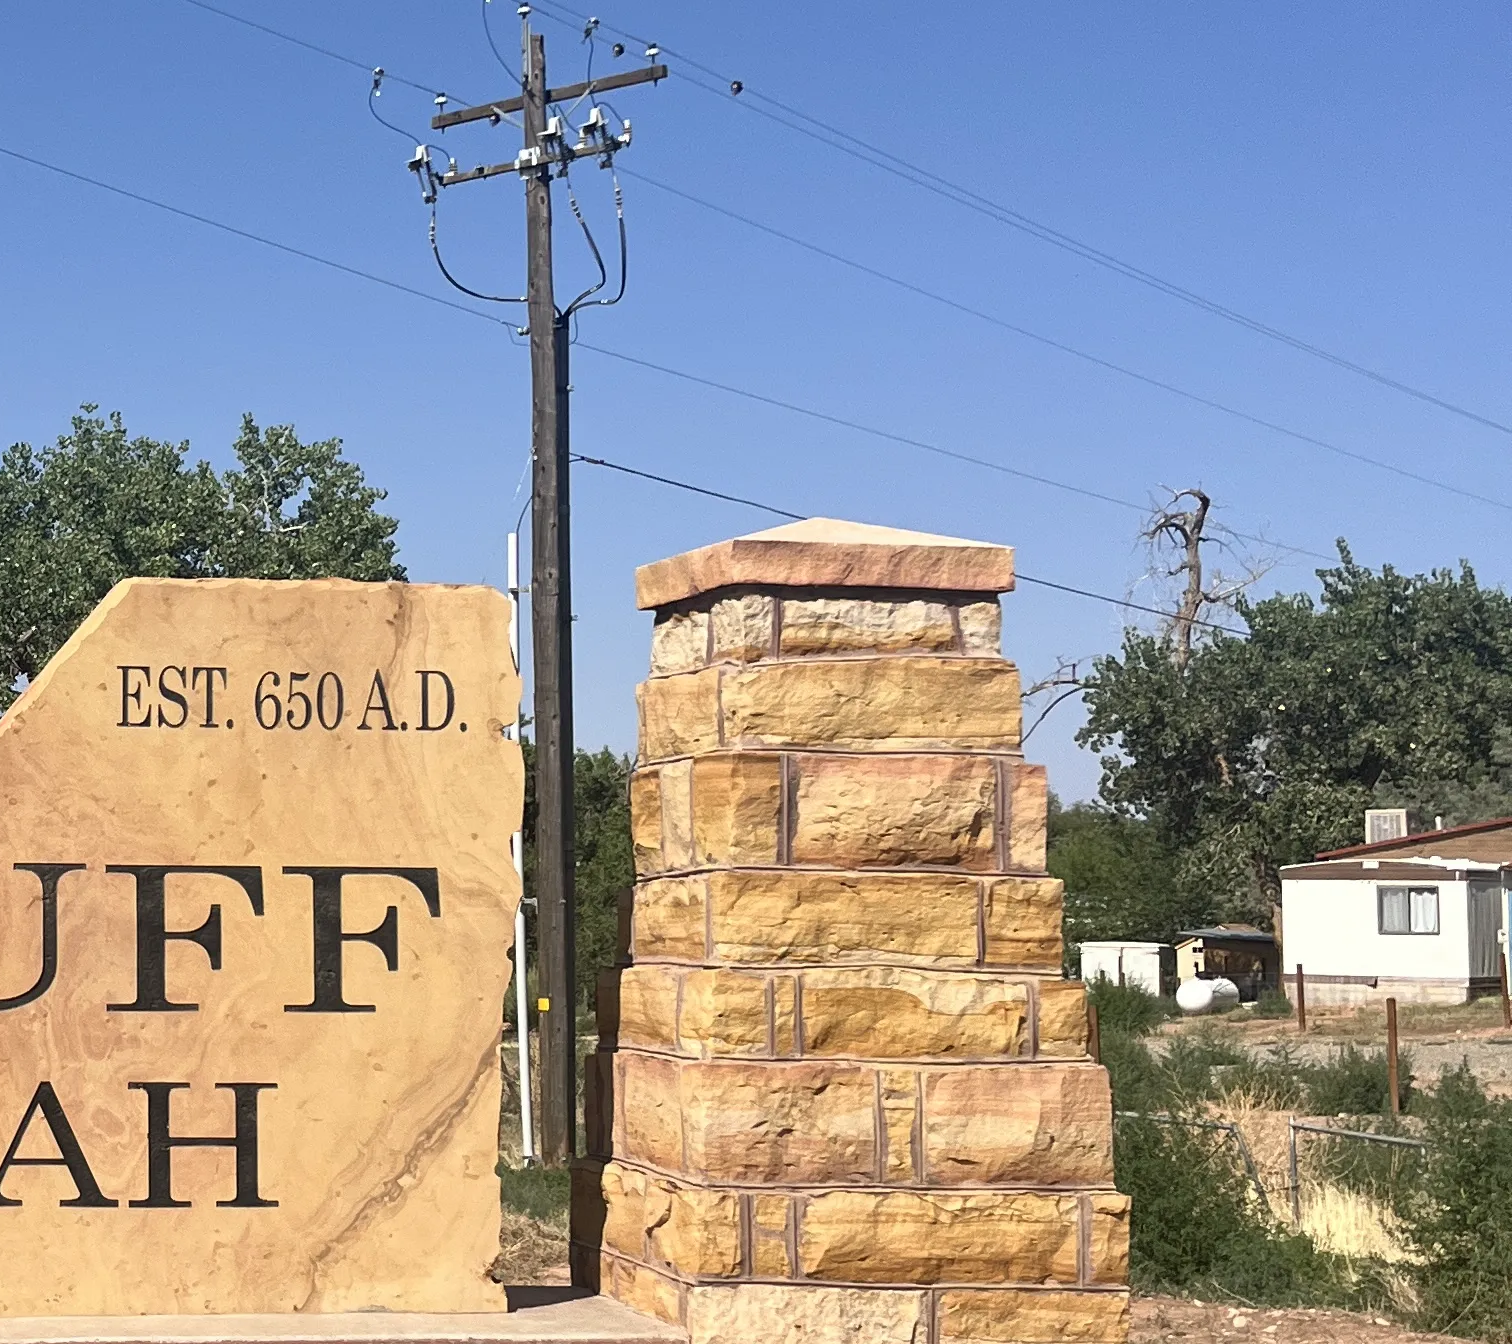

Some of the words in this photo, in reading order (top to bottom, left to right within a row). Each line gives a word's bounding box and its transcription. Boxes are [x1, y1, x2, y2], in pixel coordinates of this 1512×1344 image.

[116, 665, 234, 730] EST.
[254, 671, 344, 731] 650
[356, 668, 468, 733] A.D.
